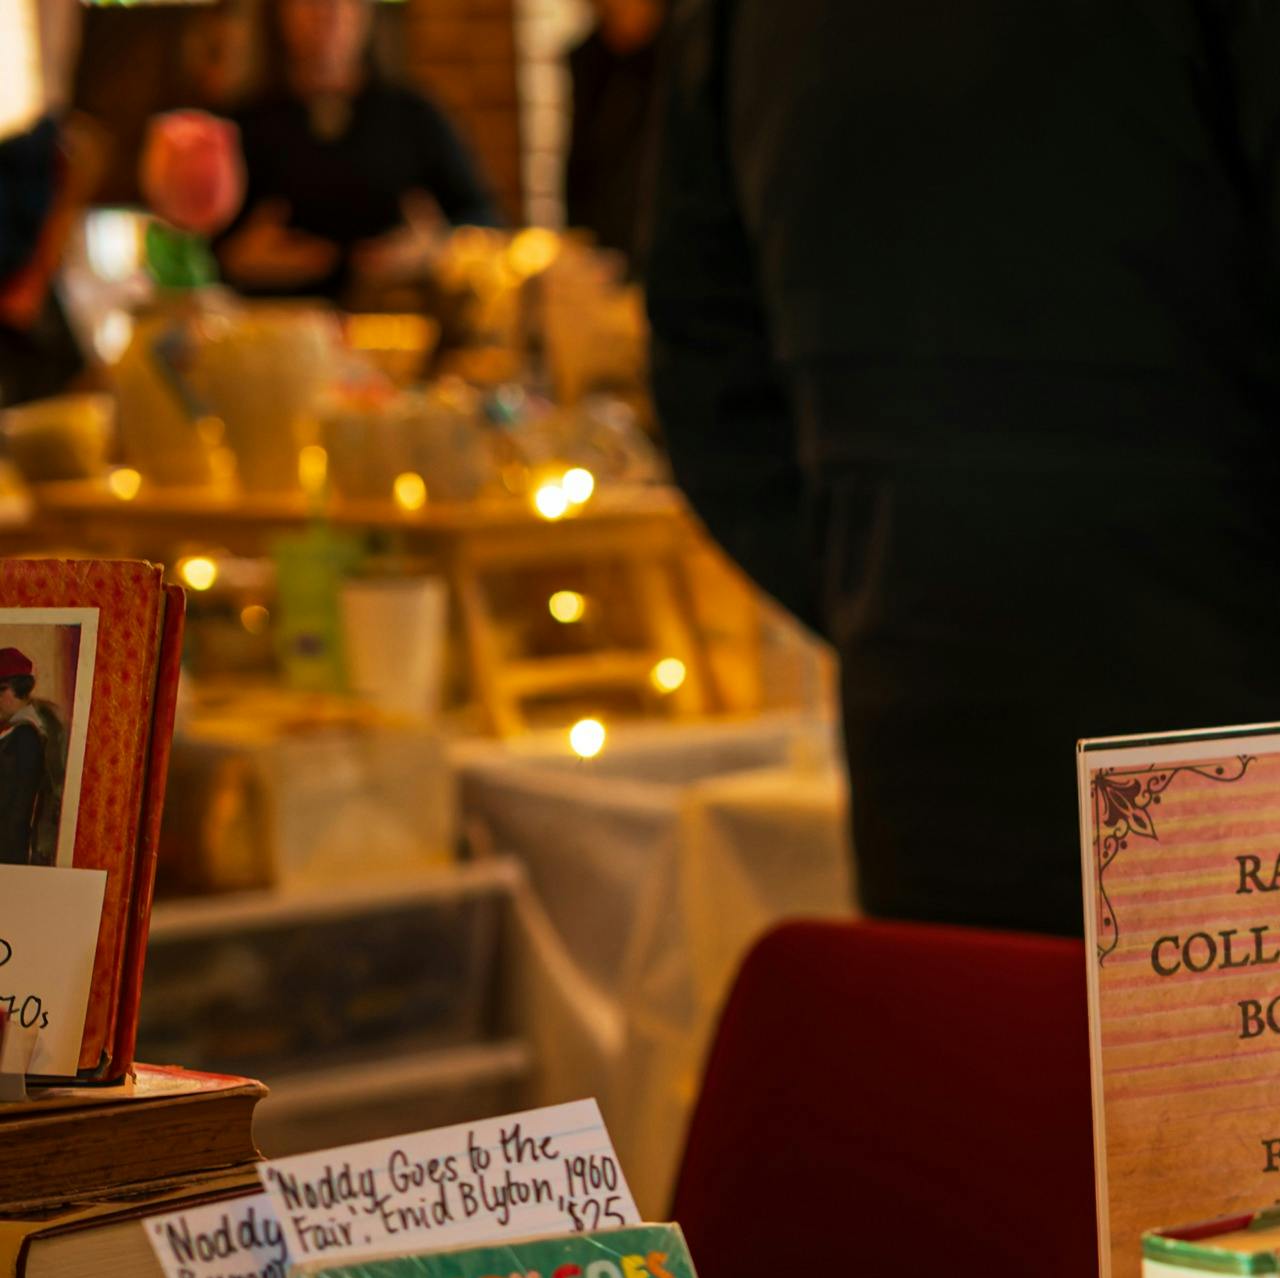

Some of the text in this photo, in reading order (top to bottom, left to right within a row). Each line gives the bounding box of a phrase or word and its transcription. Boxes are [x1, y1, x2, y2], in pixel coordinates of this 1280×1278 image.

[379, 1183, 453, 1236] Enid
[566, 1154, 618, 1197] 1960
[388, 1150, 460, 1192] Goes
[467, 1131, 491, 1175] to
[500, 1123, 560, 1172] the
